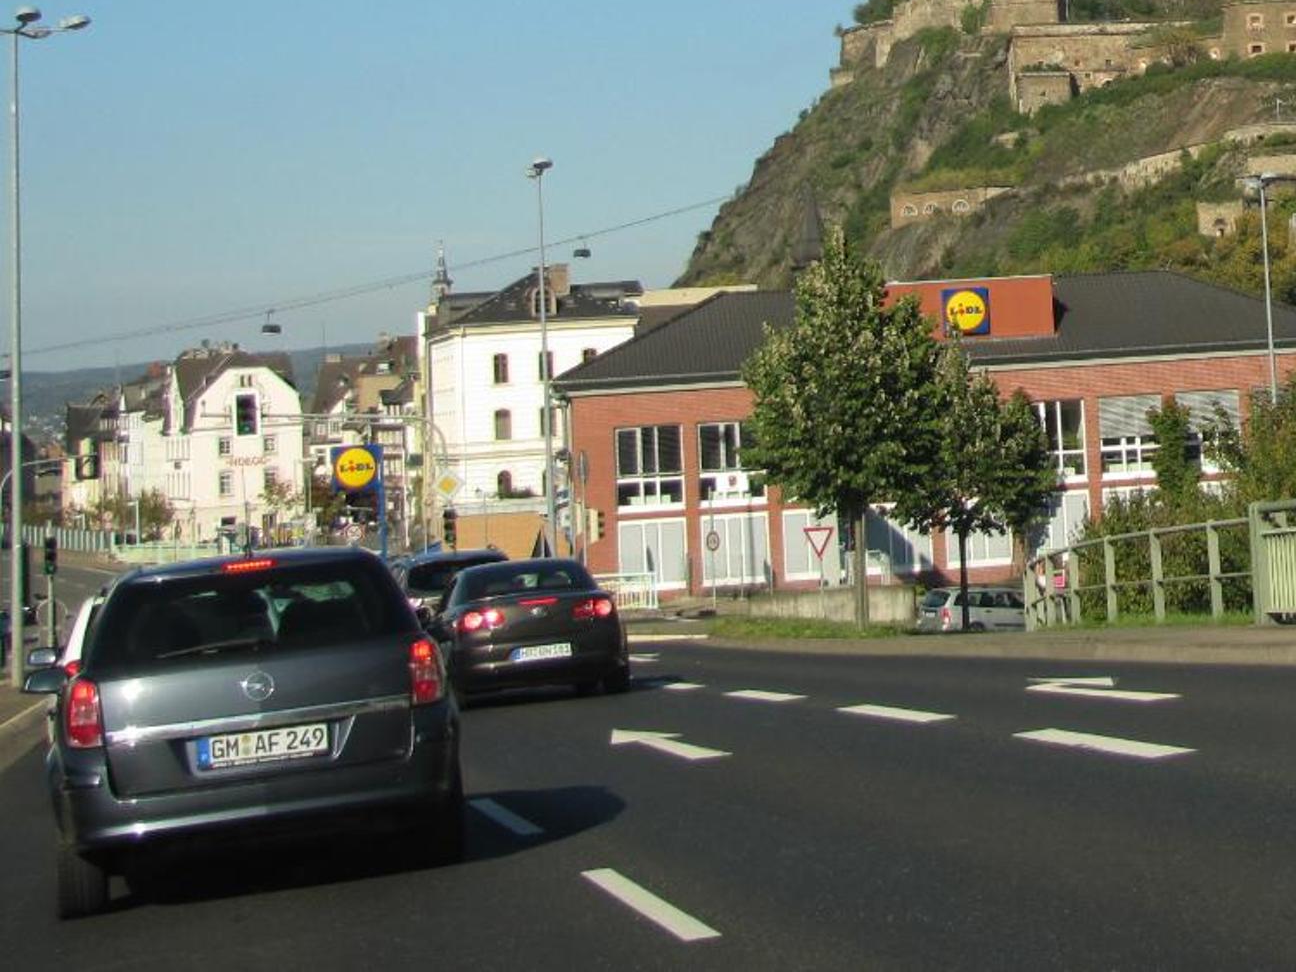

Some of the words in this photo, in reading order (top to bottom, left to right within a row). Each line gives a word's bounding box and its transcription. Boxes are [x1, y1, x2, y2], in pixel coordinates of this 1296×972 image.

[211, 738, 239, 759] GM
[255, 732, 279, 753] AF
[286, 728, 324, 750] 249
